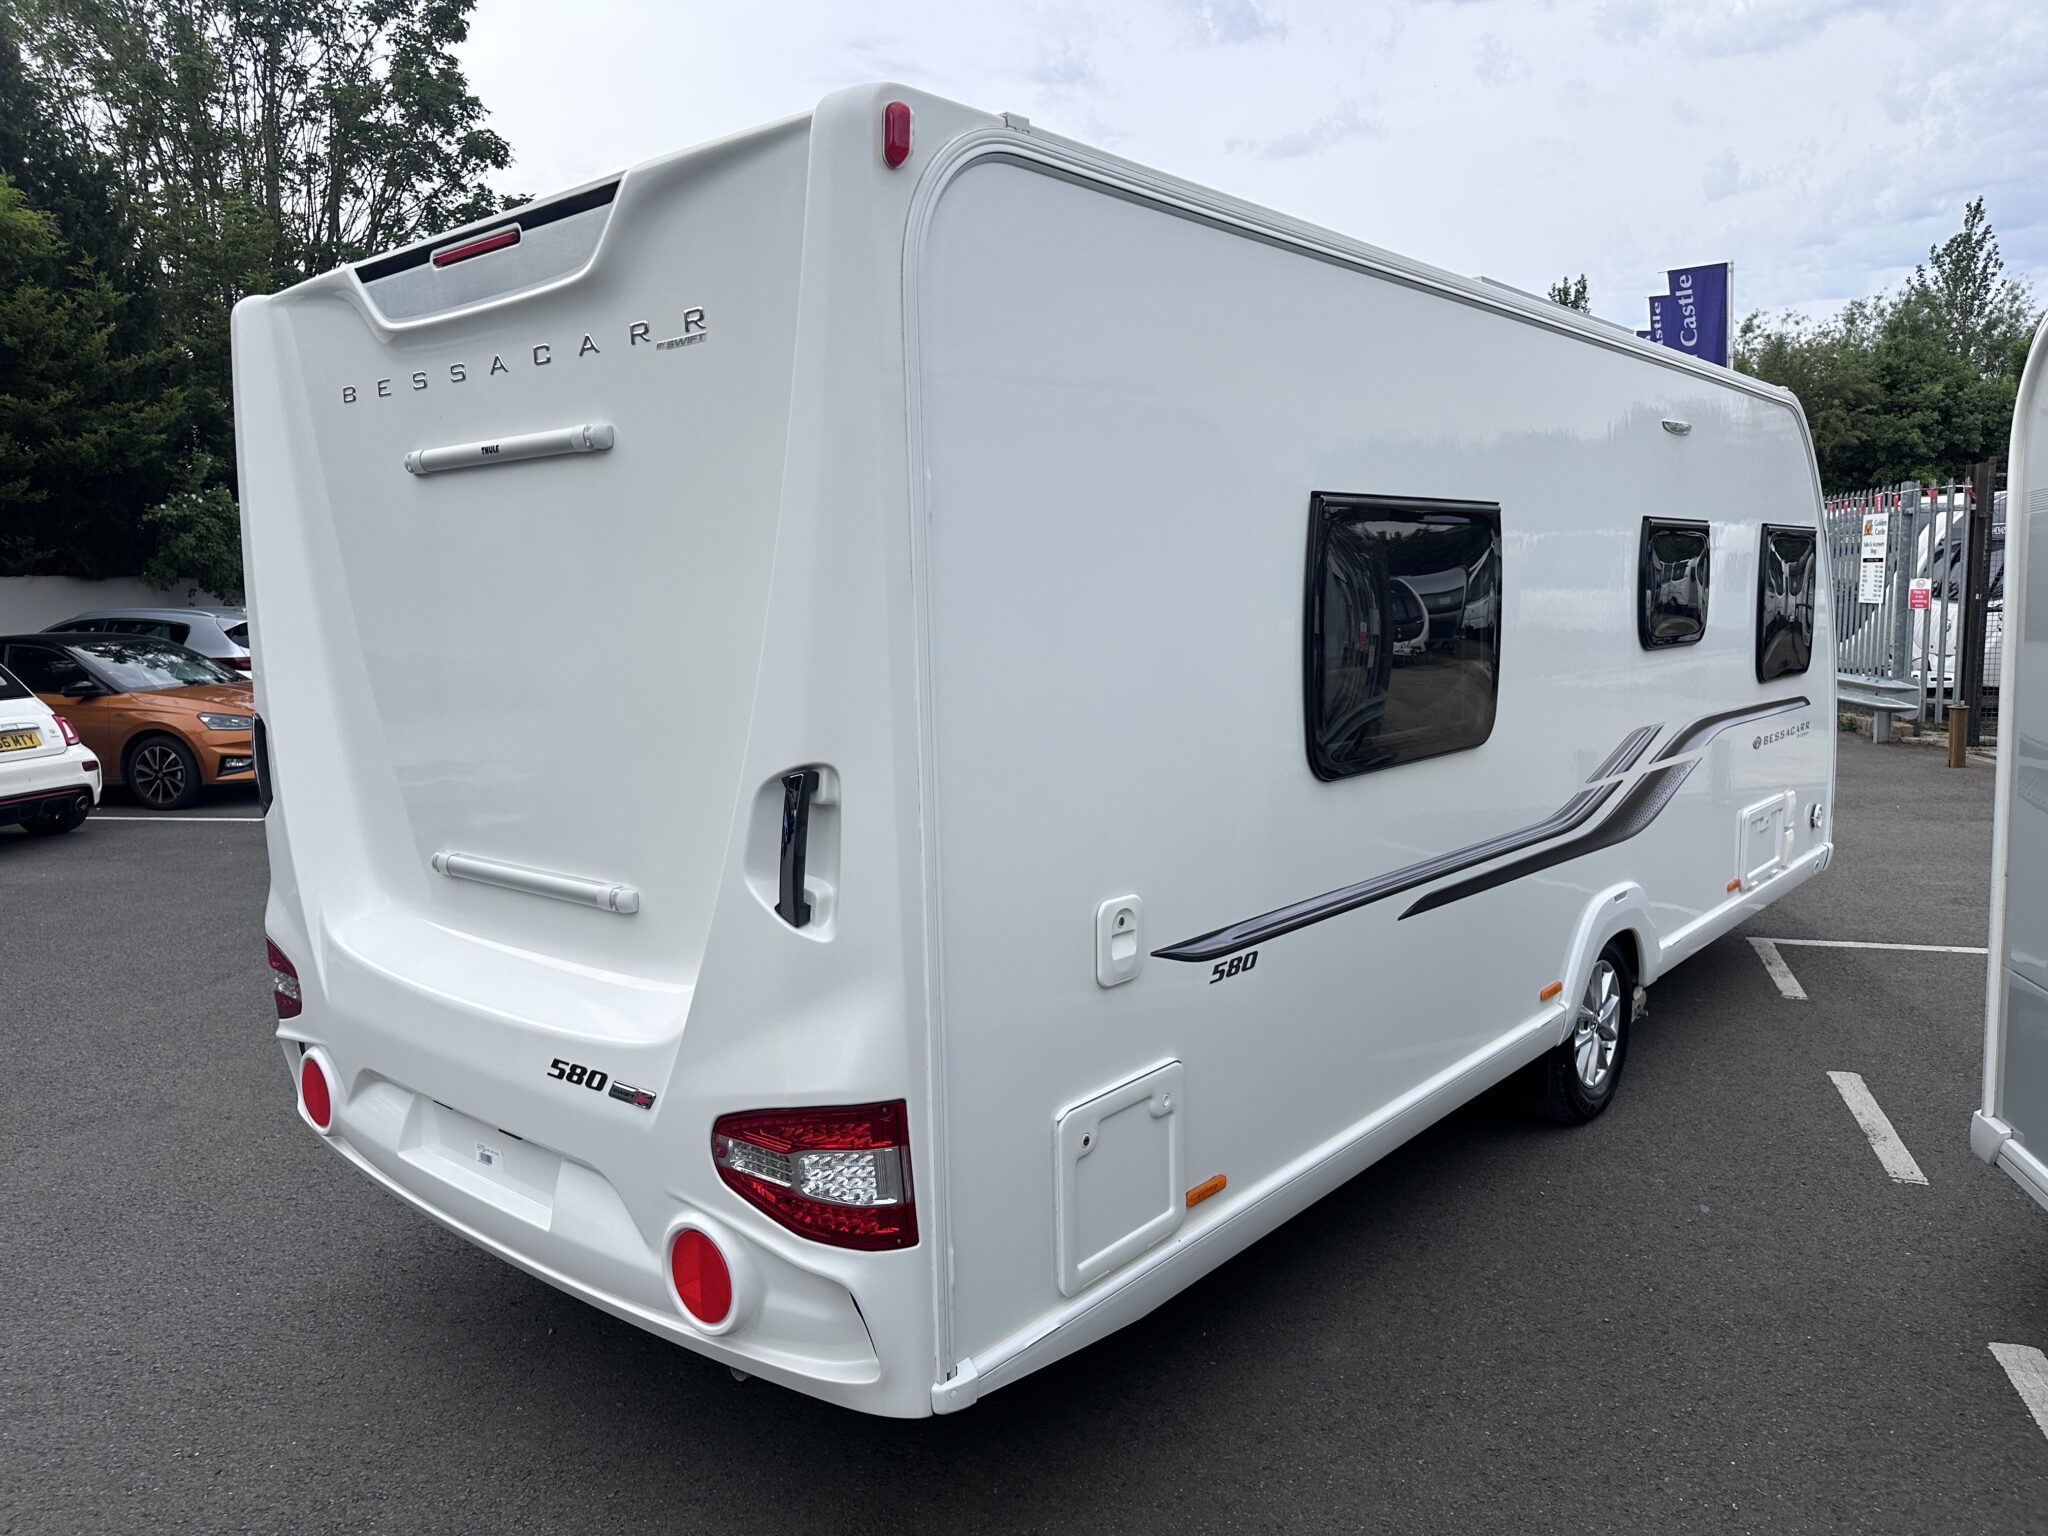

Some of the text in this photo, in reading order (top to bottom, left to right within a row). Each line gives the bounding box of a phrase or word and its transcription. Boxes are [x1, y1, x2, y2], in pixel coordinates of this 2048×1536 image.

[1672, 274, 1698, 347] Castle
[342, 306, 707, 404] BESSACARR
[666, 332, 706, 351] SWIFT
[480, 444, 500, 455] THULE
[1763, 720, 1811, 746] BESSACARR
[1209, 950, 1259, 985] 580
[546, 1058, 609, 1092] 580
